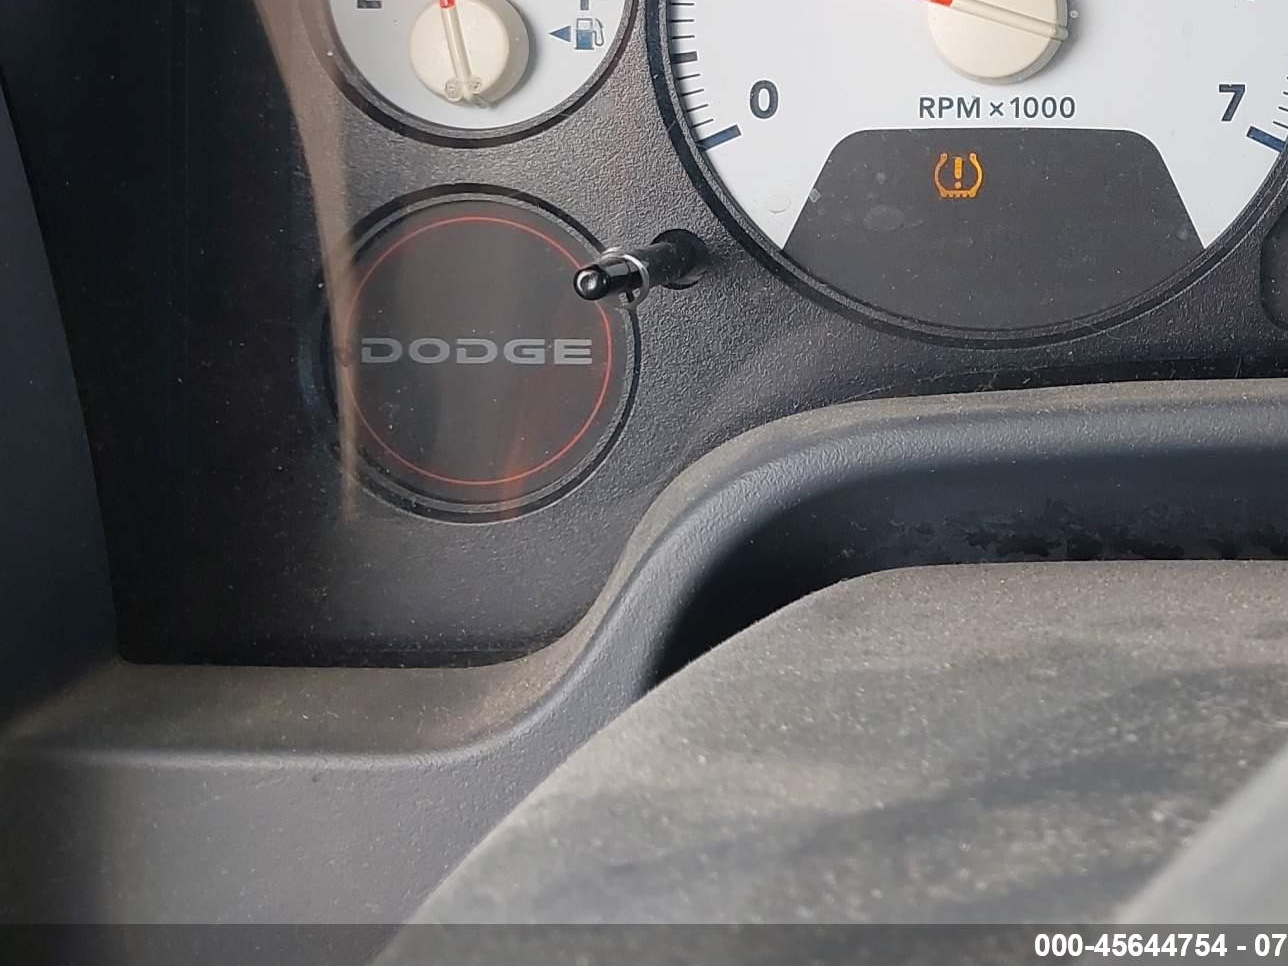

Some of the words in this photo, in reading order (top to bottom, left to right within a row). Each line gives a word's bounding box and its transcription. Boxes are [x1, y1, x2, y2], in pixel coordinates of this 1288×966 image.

[750, 80, 778, 119] 0
[920, 97, 980, 118] RPM
[1219, 84, 1245, 121] 7
[361, 338, 593, 364] DODGE
